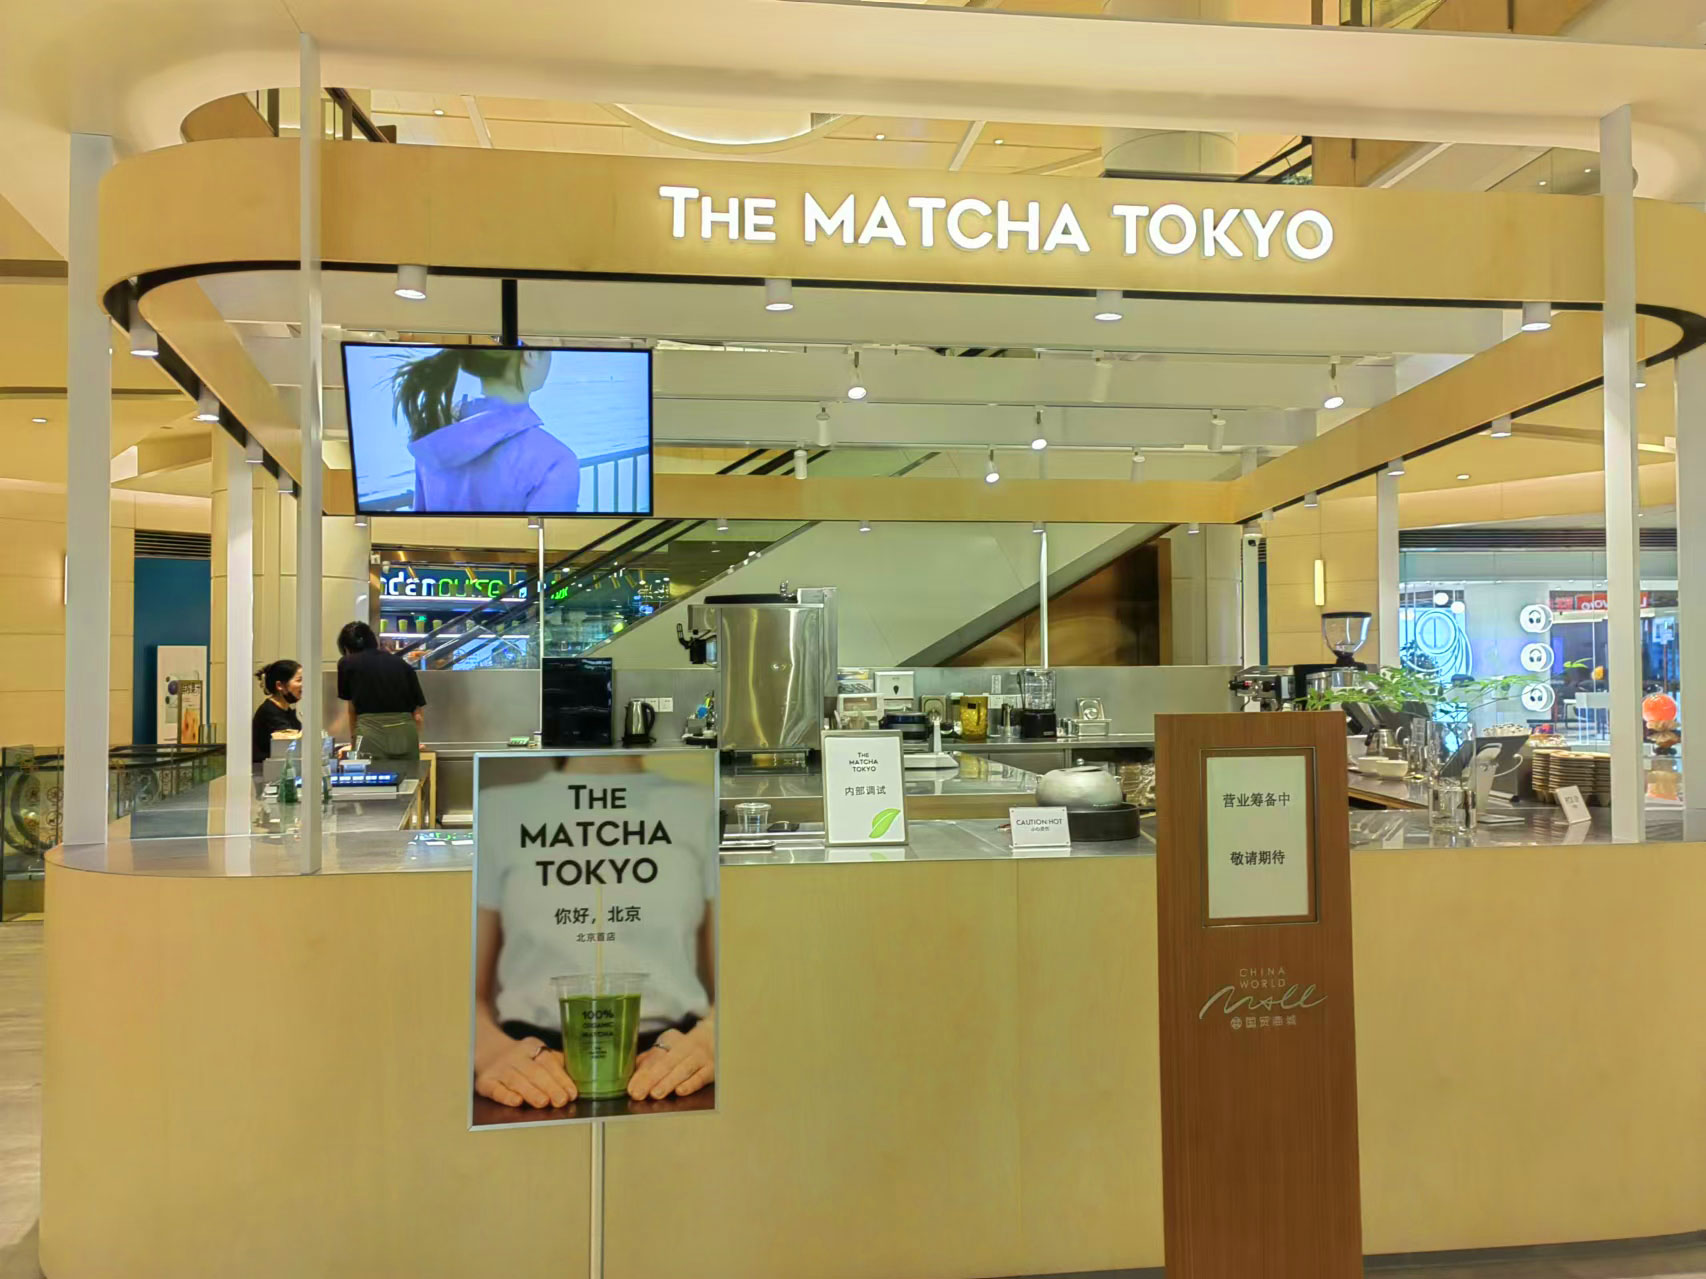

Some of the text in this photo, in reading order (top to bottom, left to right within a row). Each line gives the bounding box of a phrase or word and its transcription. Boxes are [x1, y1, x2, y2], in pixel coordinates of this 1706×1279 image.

[658, 185, 1335, 261] THE MATCHA TOKYO
[568, 784, 627, 810] THE
[845, 785, 886, 796] 内部调试
[1222, 792, 1291, 808] 营业筹备中
[520, 820, 673, 848] MATCHA
[1230, 850, 1286, 866] 敬请期待
[535, 857, 659, 887] TOKYO
[575, 932, 616, 943] 北京首店
[1239, 966, 1286, 977] CHINA
[1239, 979, 1286, 989] WORLD
[582, 1009, 615, 1020] 100%
